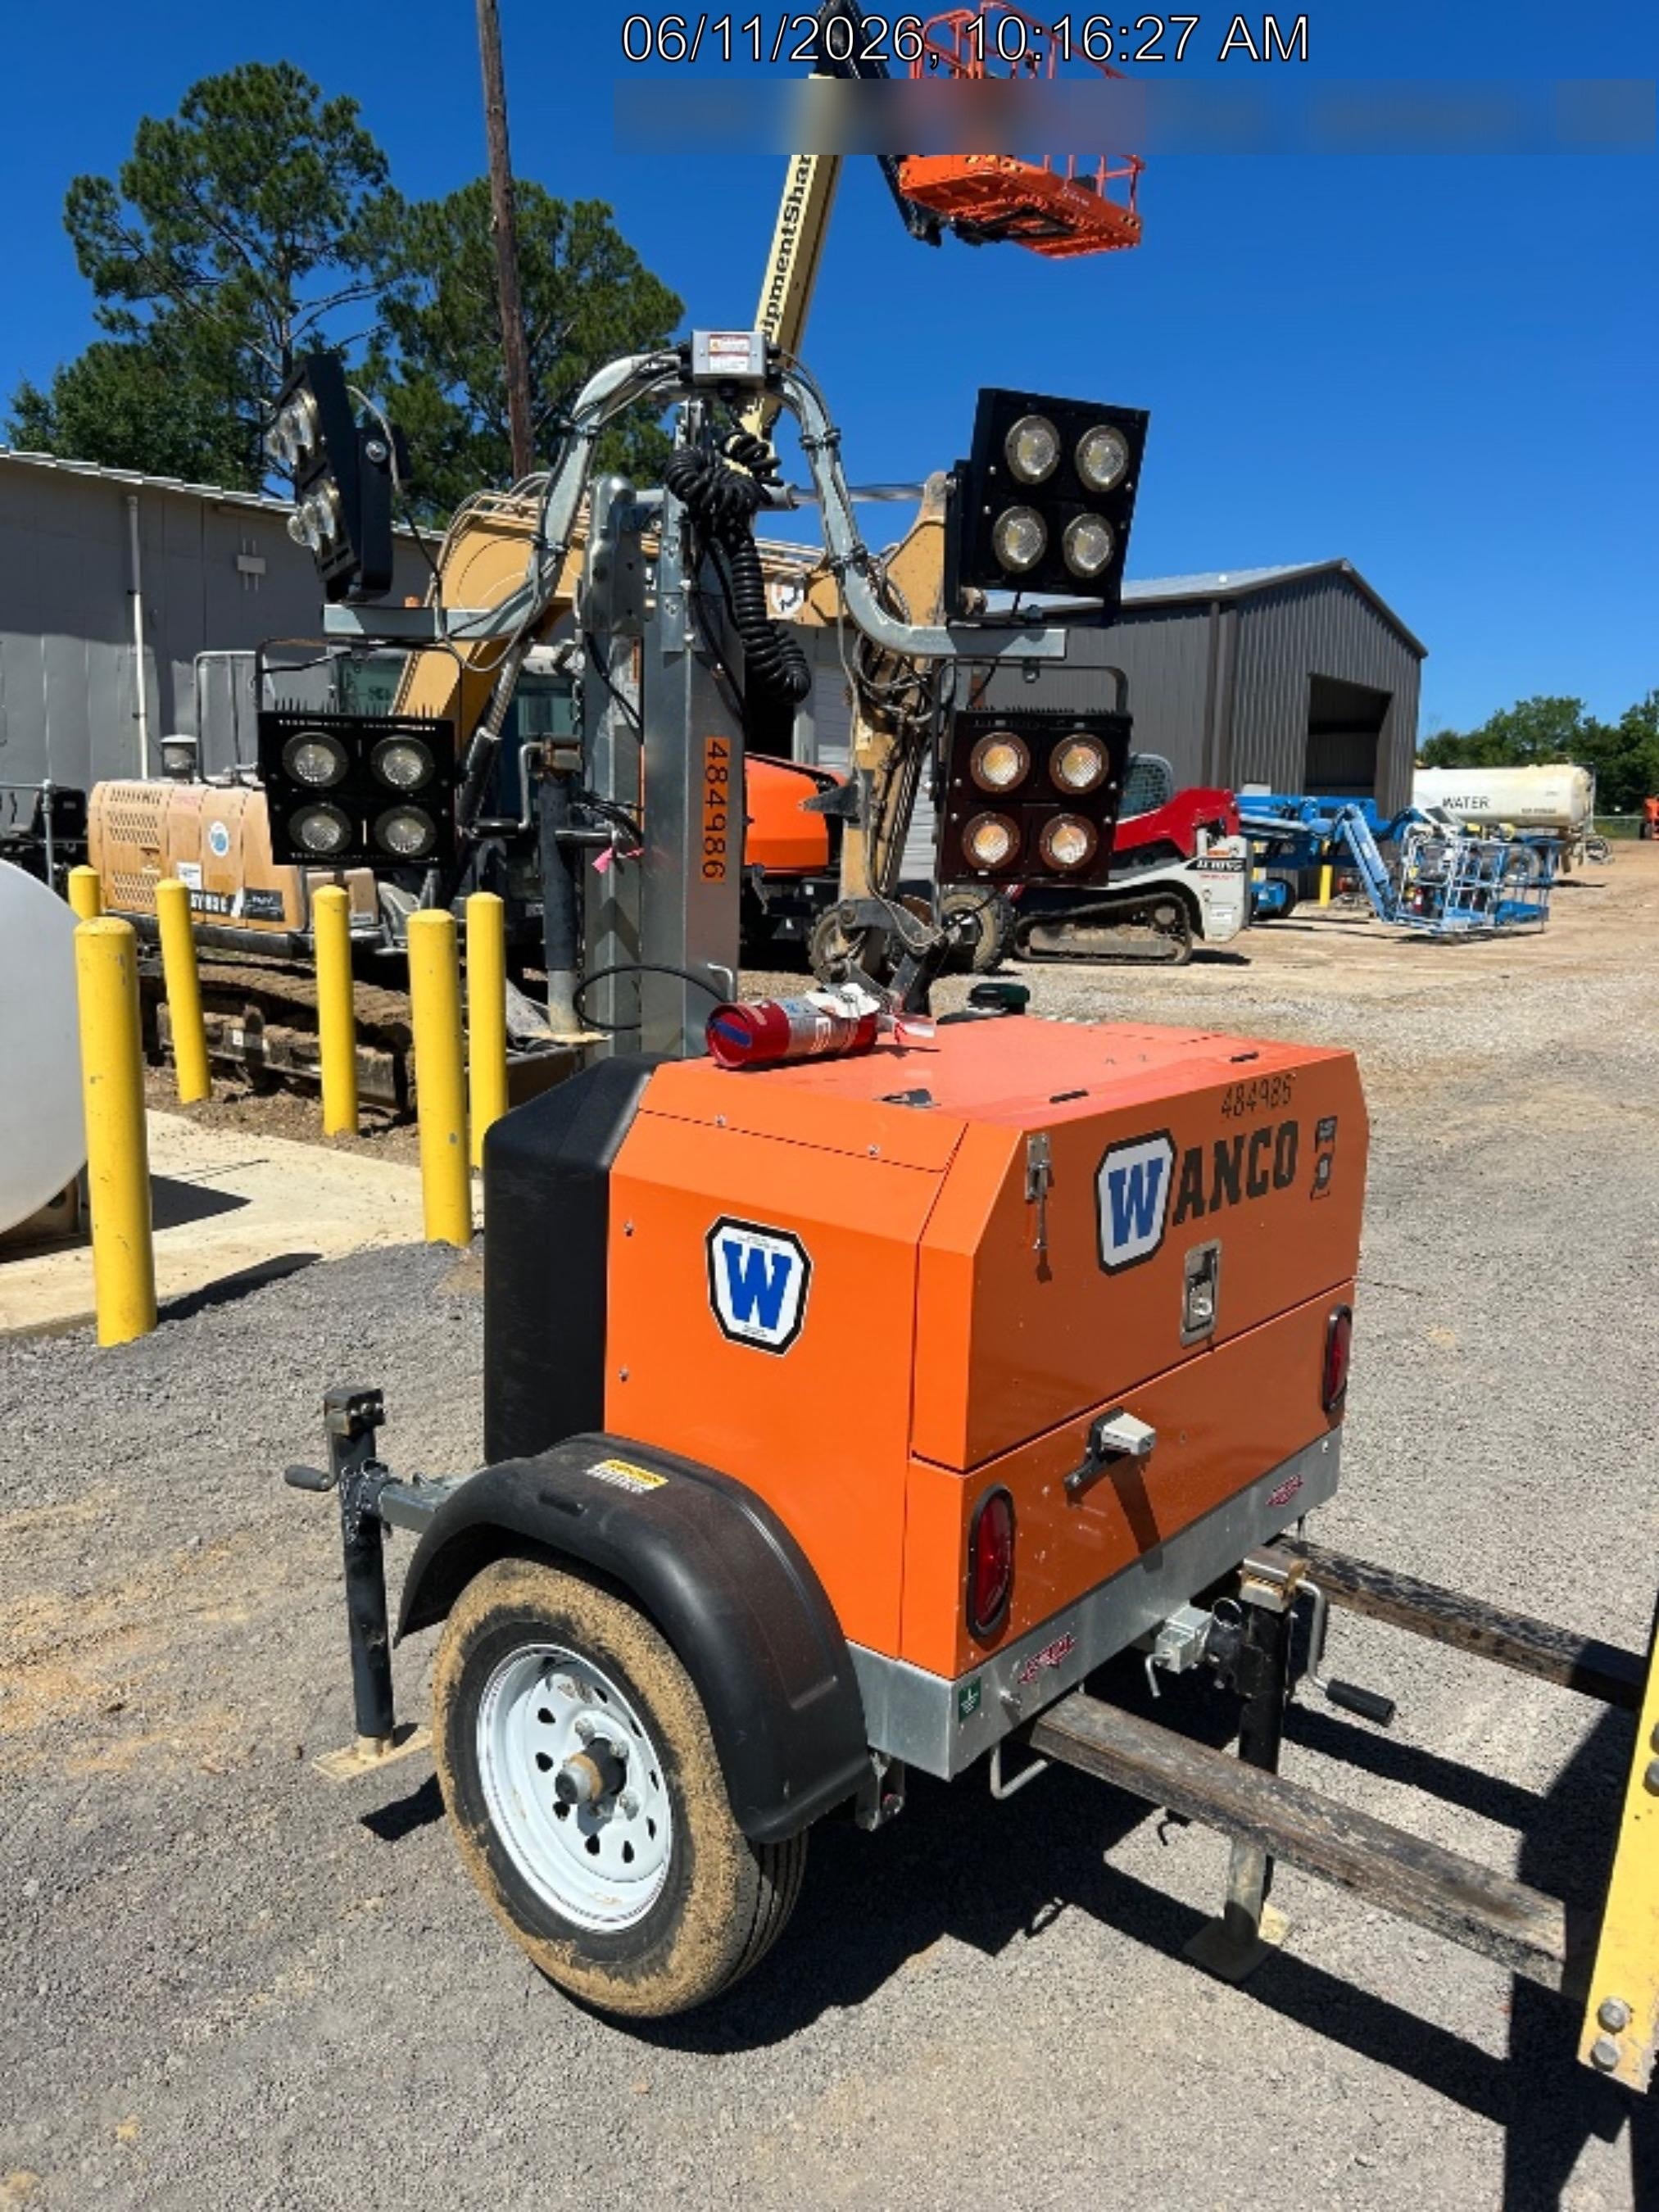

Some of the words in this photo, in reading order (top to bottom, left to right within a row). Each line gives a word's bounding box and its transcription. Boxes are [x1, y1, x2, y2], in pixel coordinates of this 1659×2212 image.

[702, 741, 728, 879] 484986
[1442, 796, 1490, 809] WATER
[722, 1239, 792, 1330] W
